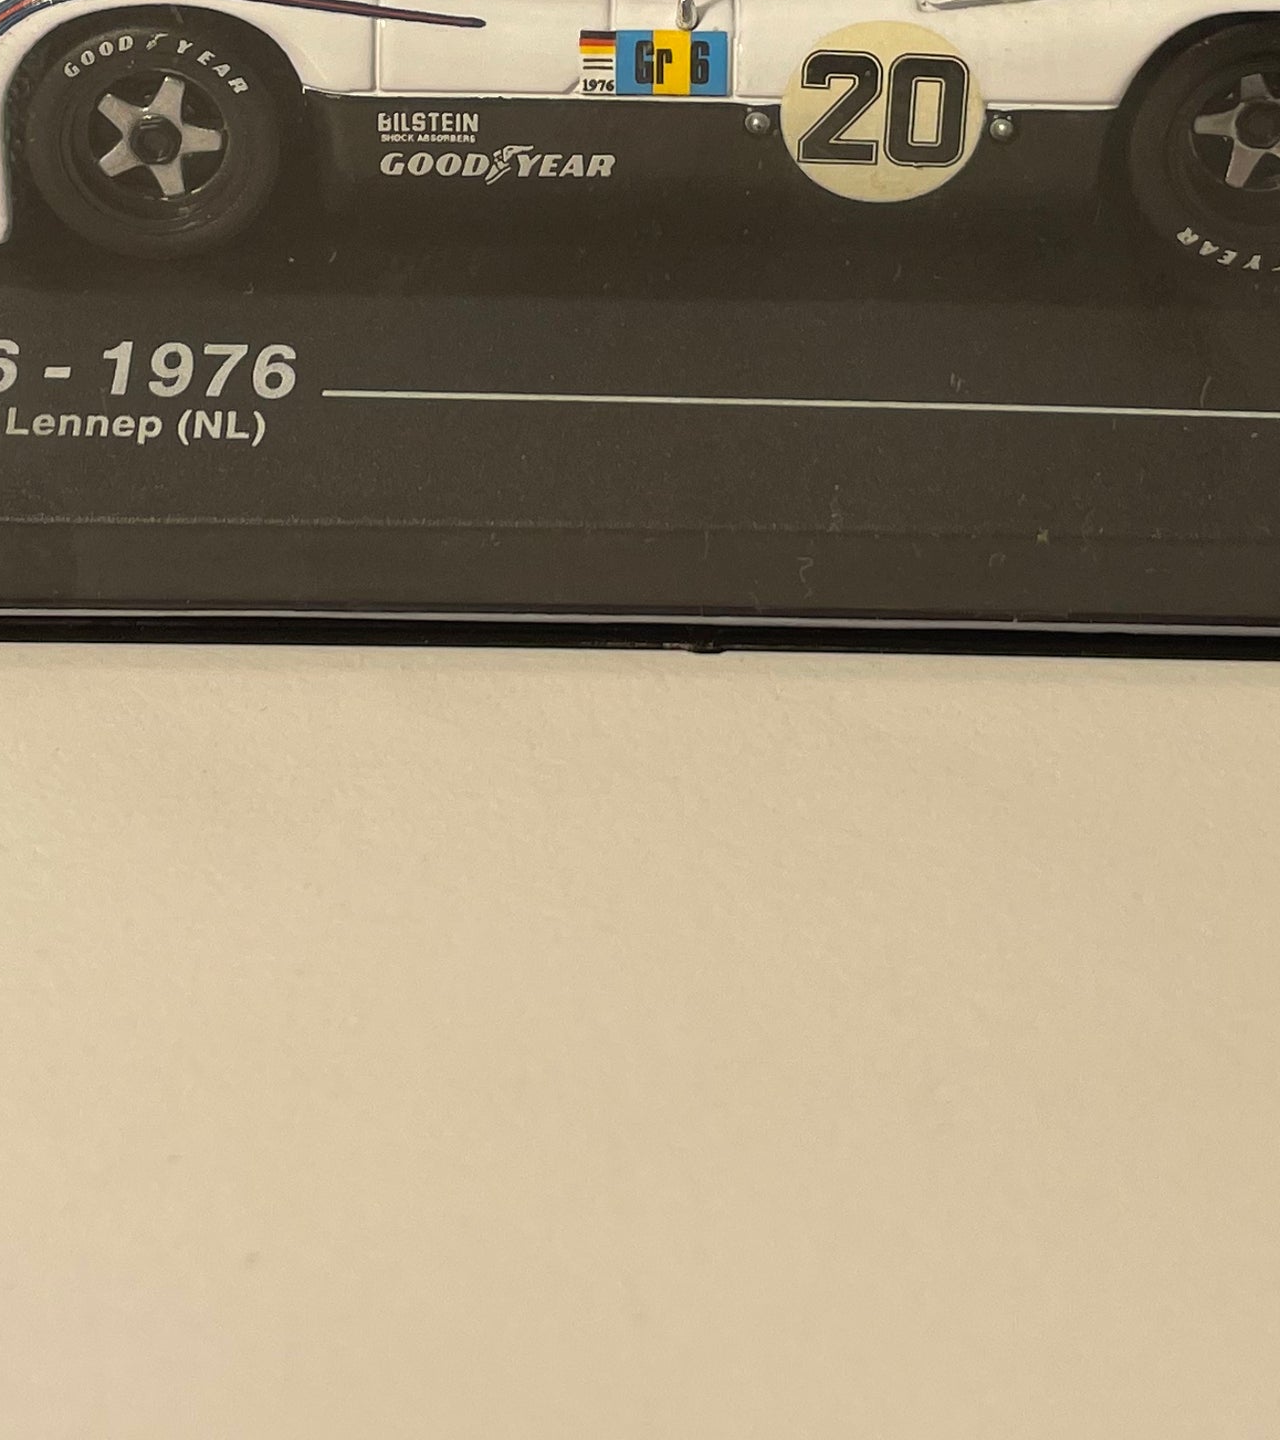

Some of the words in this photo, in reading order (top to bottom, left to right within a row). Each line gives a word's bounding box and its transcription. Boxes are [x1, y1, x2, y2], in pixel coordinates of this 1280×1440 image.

[635, 40, 673, 85] Gr
[690, 40, 710, 85] 6
[582, 78, 615, 92] 1976
[377, 112, 479, 132] BILSTEIN
[797, 48, 968, 168] 20
[380, 134, 415, 143] SHOCK
[380, 145, 616, 185] GOODYEAR
[103, 341, 297, 400] 1976
[5, 407, 163, 445] Lennep
[177, 409, 266, 447] (NL)
